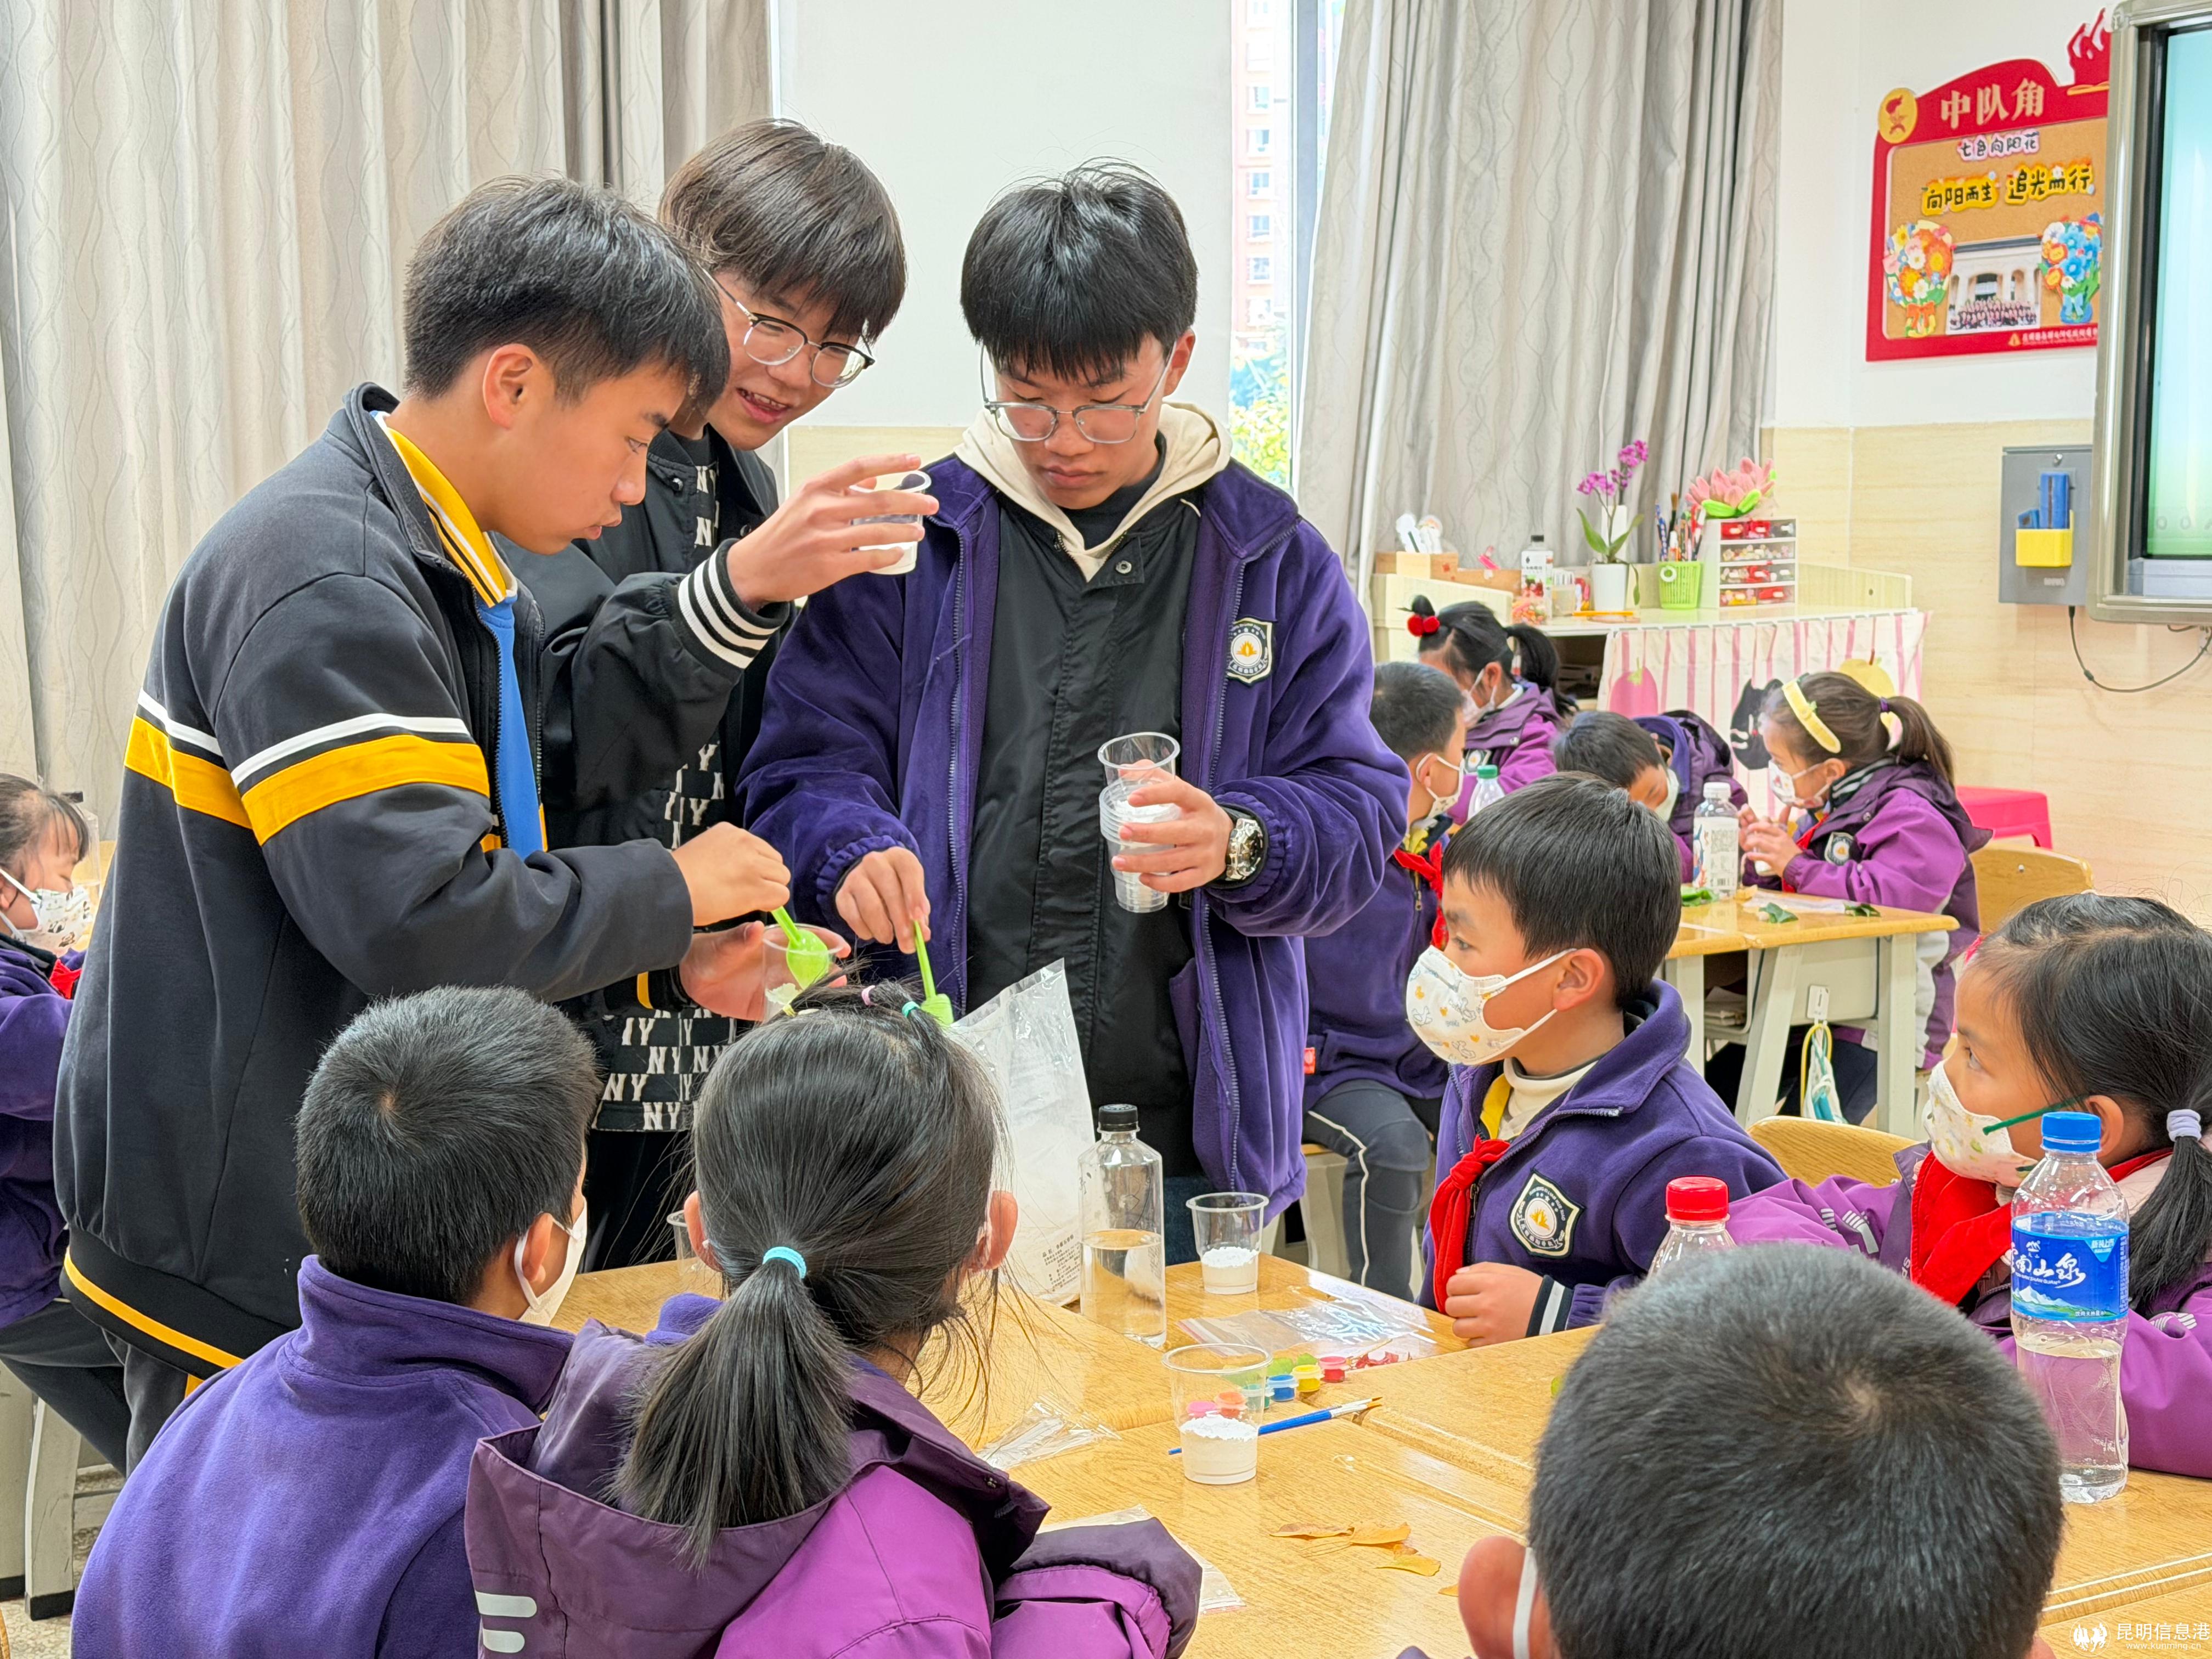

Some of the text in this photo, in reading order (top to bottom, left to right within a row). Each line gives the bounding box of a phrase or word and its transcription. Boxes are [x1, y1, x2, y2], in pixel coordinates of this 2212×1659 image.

[1940, 77, 2045, 129] 中队角
[1961, 131, 2040, 157] 七色向阳花
[1927, 168, 2091, 209] 向阳而生 追光而行
[602, 1073, 650, 1102] NY
[642, 1102, 681, 1130] NY
